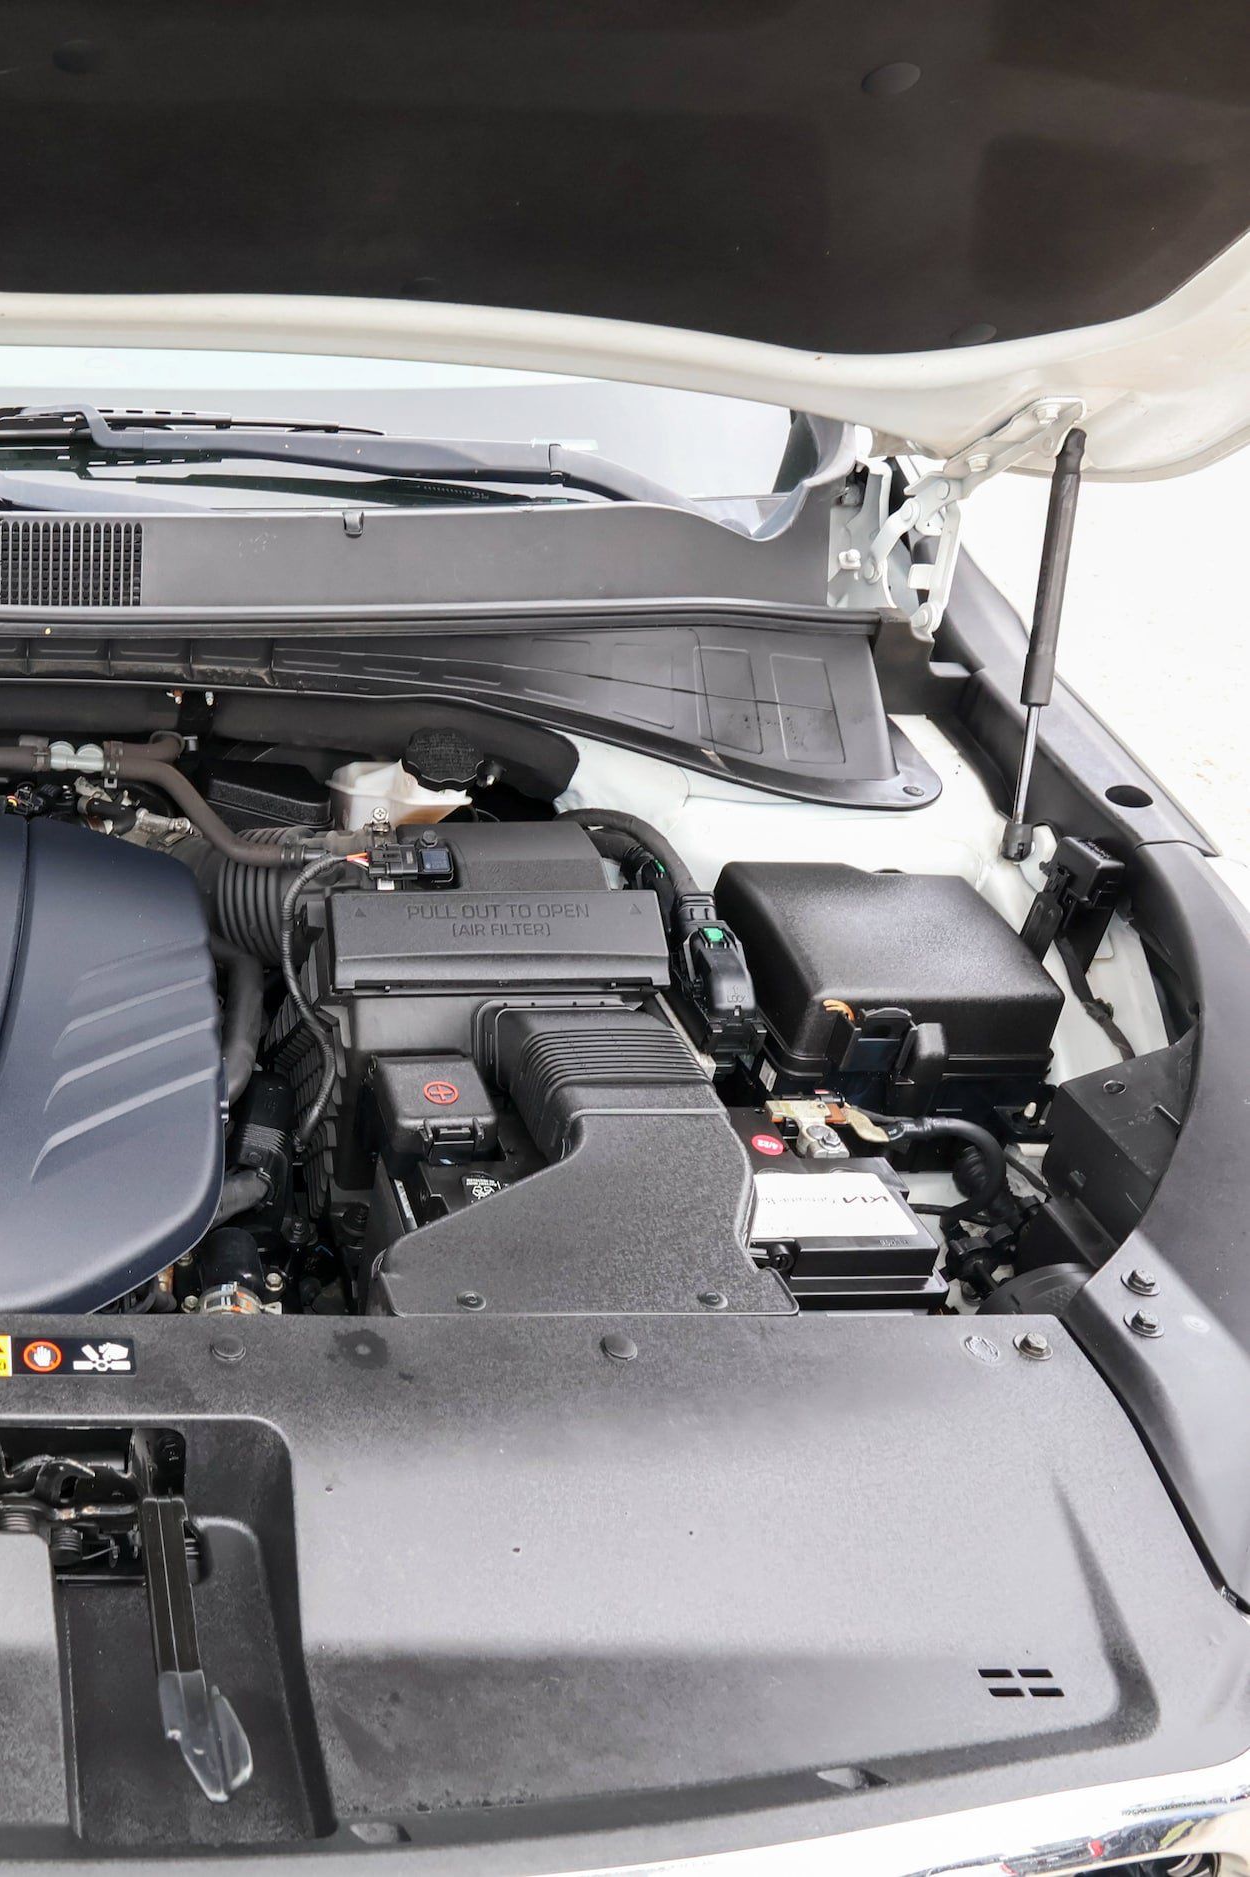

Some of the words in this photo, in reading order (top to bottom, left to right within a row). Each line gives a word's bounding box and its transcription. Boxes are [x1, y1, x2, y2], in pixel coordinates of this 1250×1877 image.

[407, 903, 457, 920] PULL
[461, 903, 500, 919] OUT
[507, 903, 531, 919] TO
[537, 903, 589, 919] OPEN
